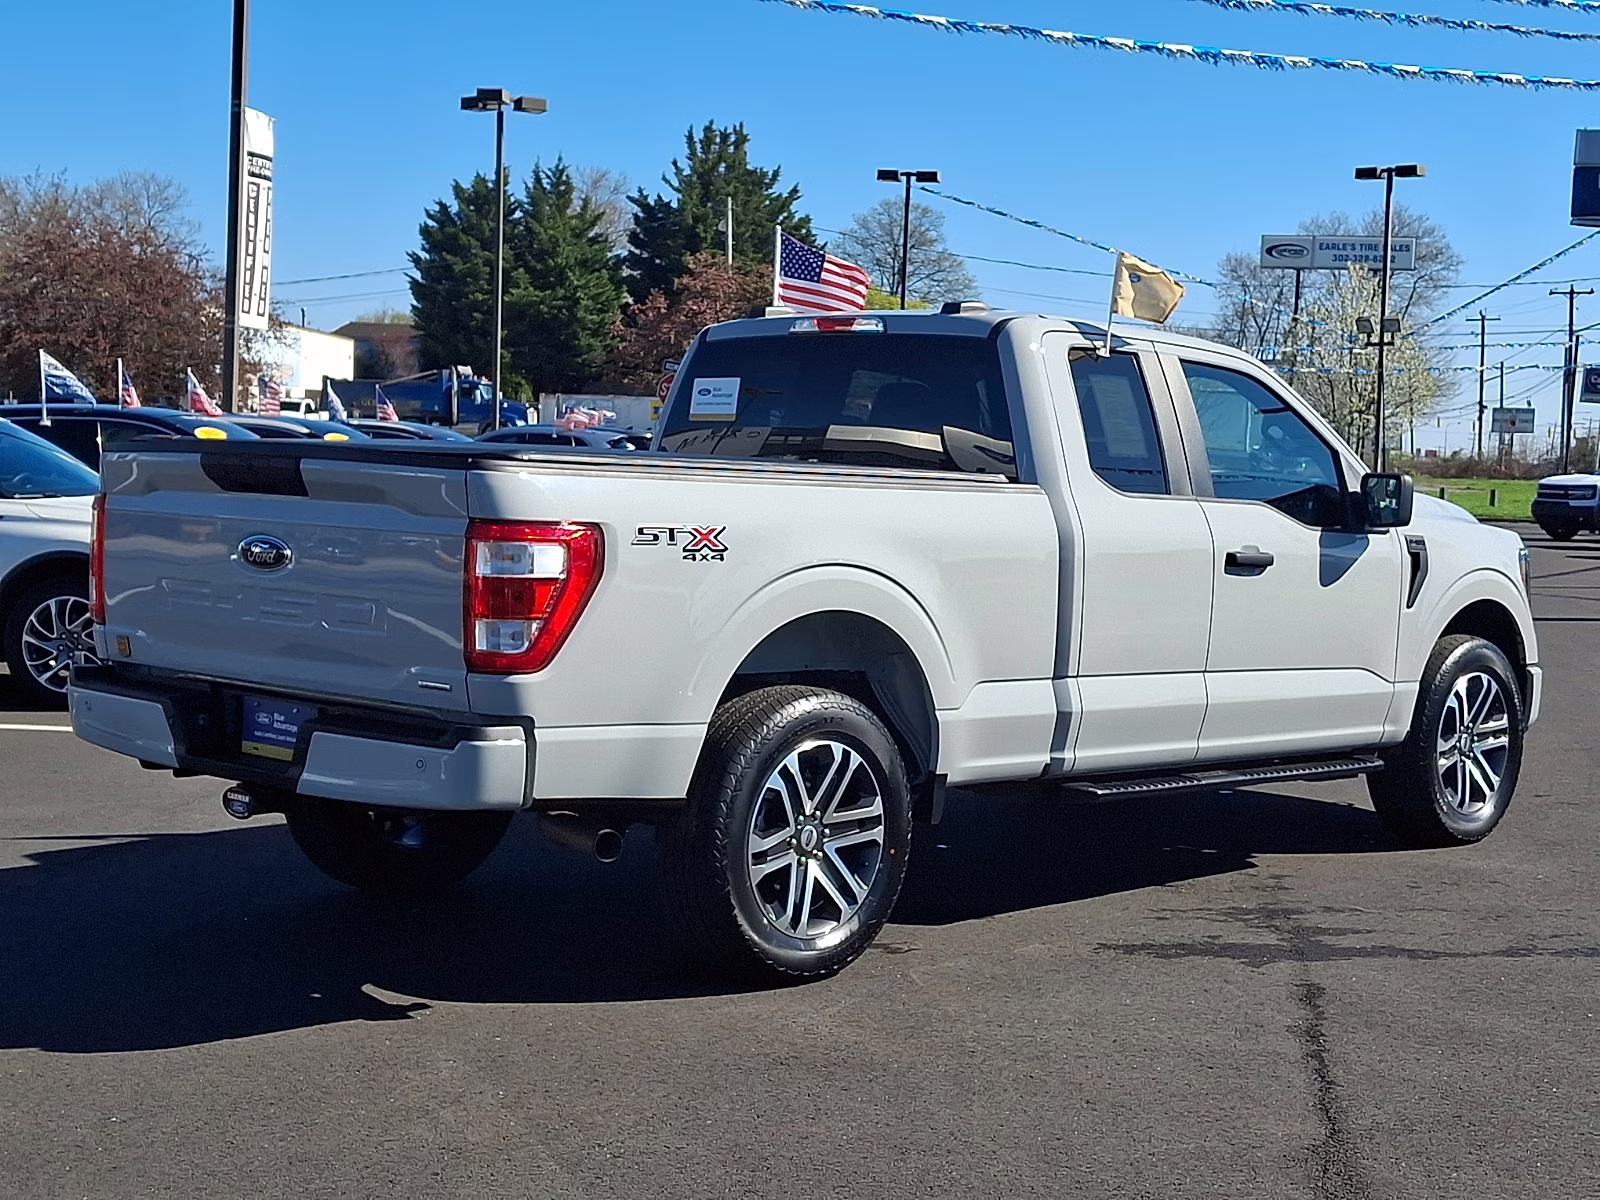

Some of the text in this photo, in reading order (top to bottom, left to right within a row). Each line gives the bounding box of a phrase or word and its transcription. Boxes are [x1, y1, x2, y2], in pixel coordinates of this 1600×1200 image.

[1318, 242, 1411, 253] EARLE'S TIRE ALES
[1331, 253, 1396, 264] 302-328-822
[631, 525, 729, 553] STX
[246, 541, 279, 564] Ford
[682, 552, 725, 562] 4x4
